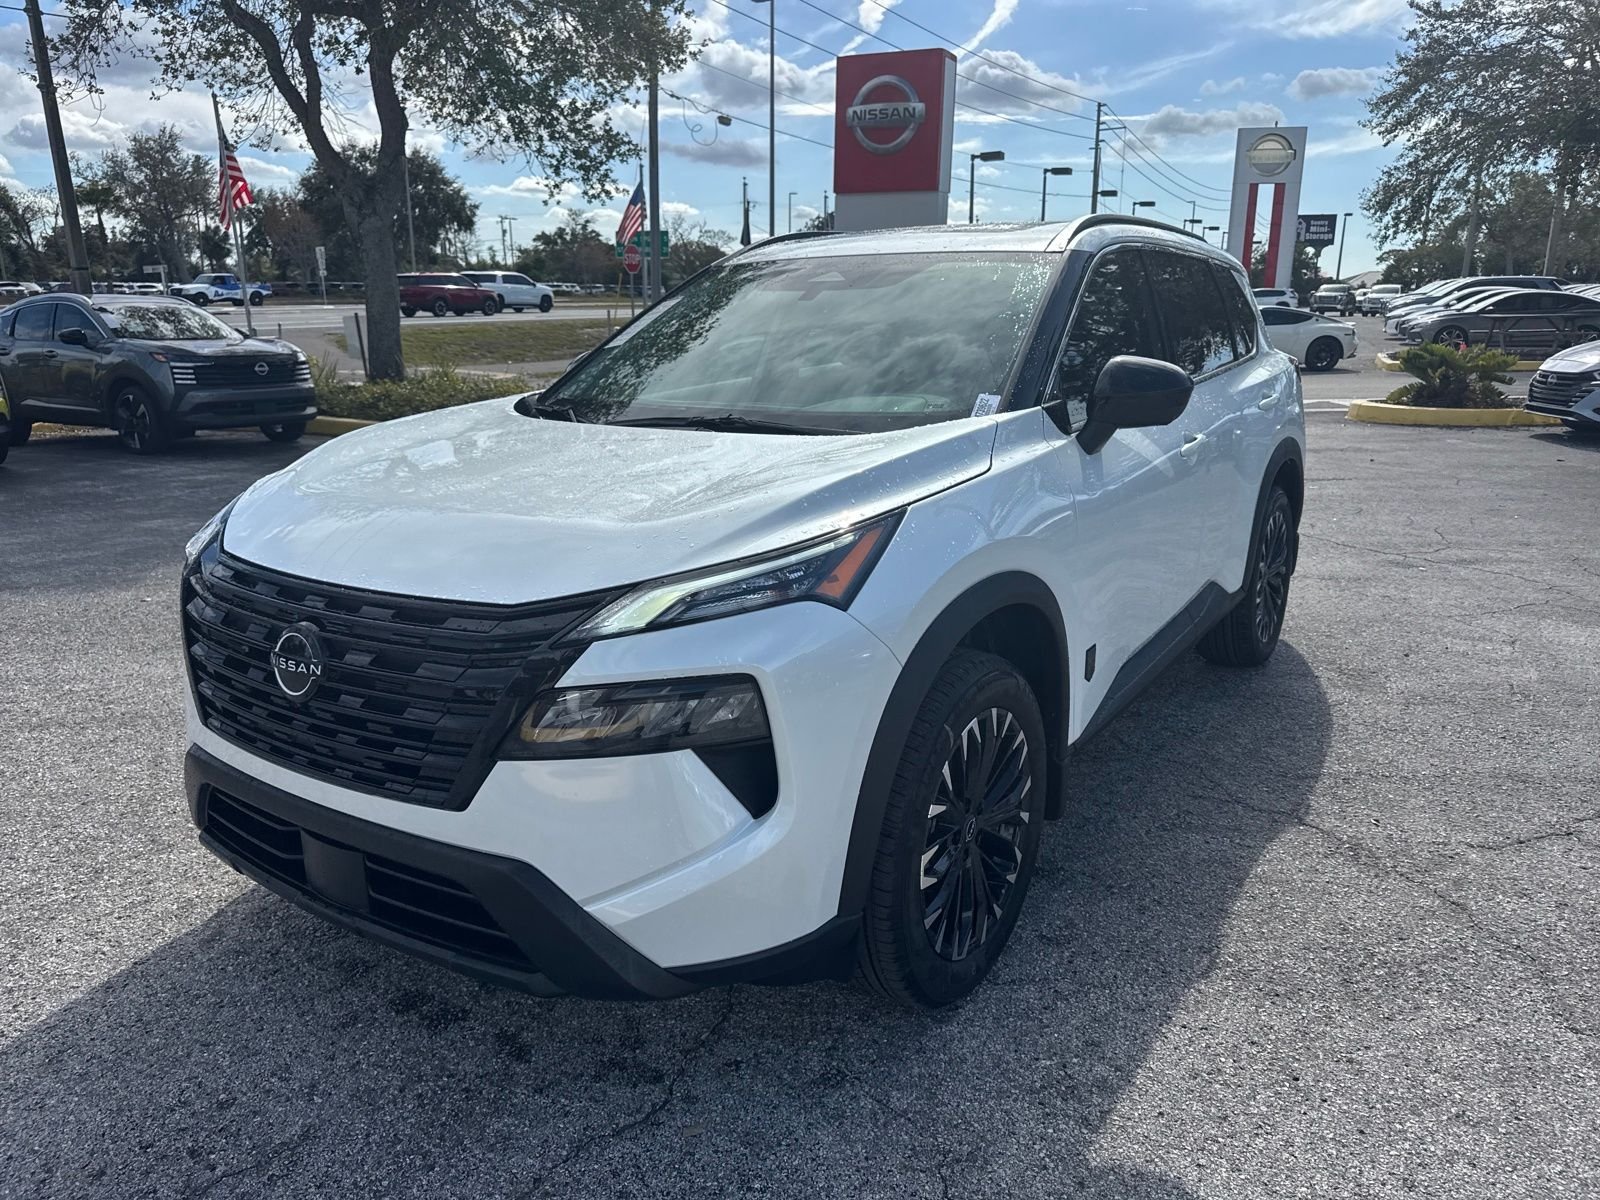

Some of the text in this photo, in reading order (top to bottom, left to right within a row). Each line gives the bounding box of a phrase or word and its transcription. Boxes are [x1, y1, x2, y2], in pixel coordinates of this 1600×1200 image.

[852, 106, 916, 121] NISSAN
[1305, 232, 1333, 240] Storage
[624, 253, 640, 264] STOP
[270, 651, 321, 676] NISSAN
